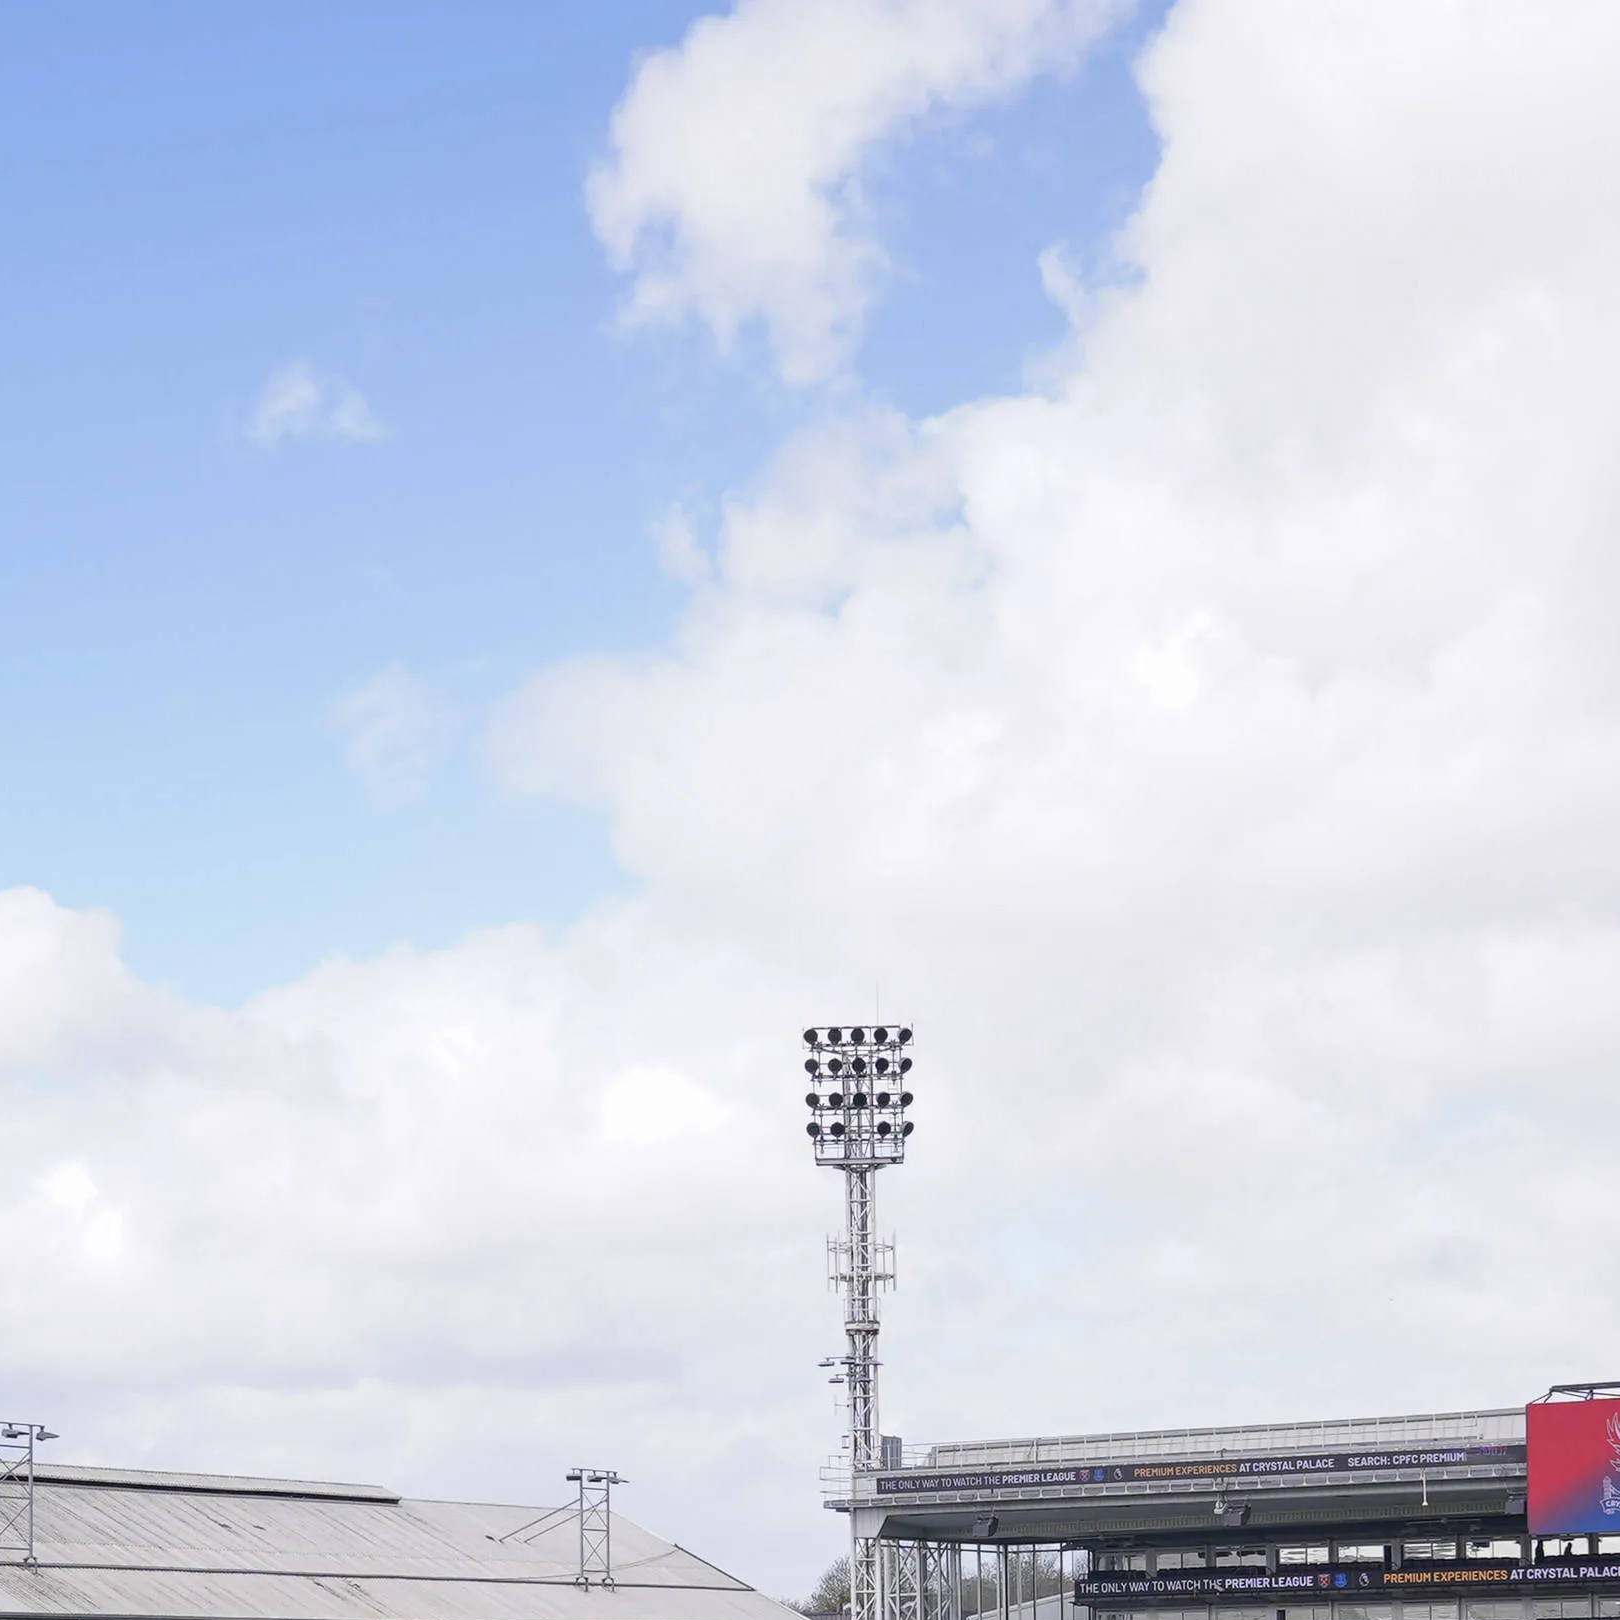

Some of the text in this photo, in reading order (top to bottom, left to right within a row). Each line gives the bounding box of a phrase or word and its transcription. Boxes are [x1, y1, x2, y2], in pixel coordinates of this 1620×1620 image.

[1384, 1572, 1431, 1583] PREMIUM
[1433, 1569, 1507, 1581] EXPERIENCES
[1510, 1569, 1524, 1579] AT
[1526, 1568, 1577, 1579] CRYSTAL
